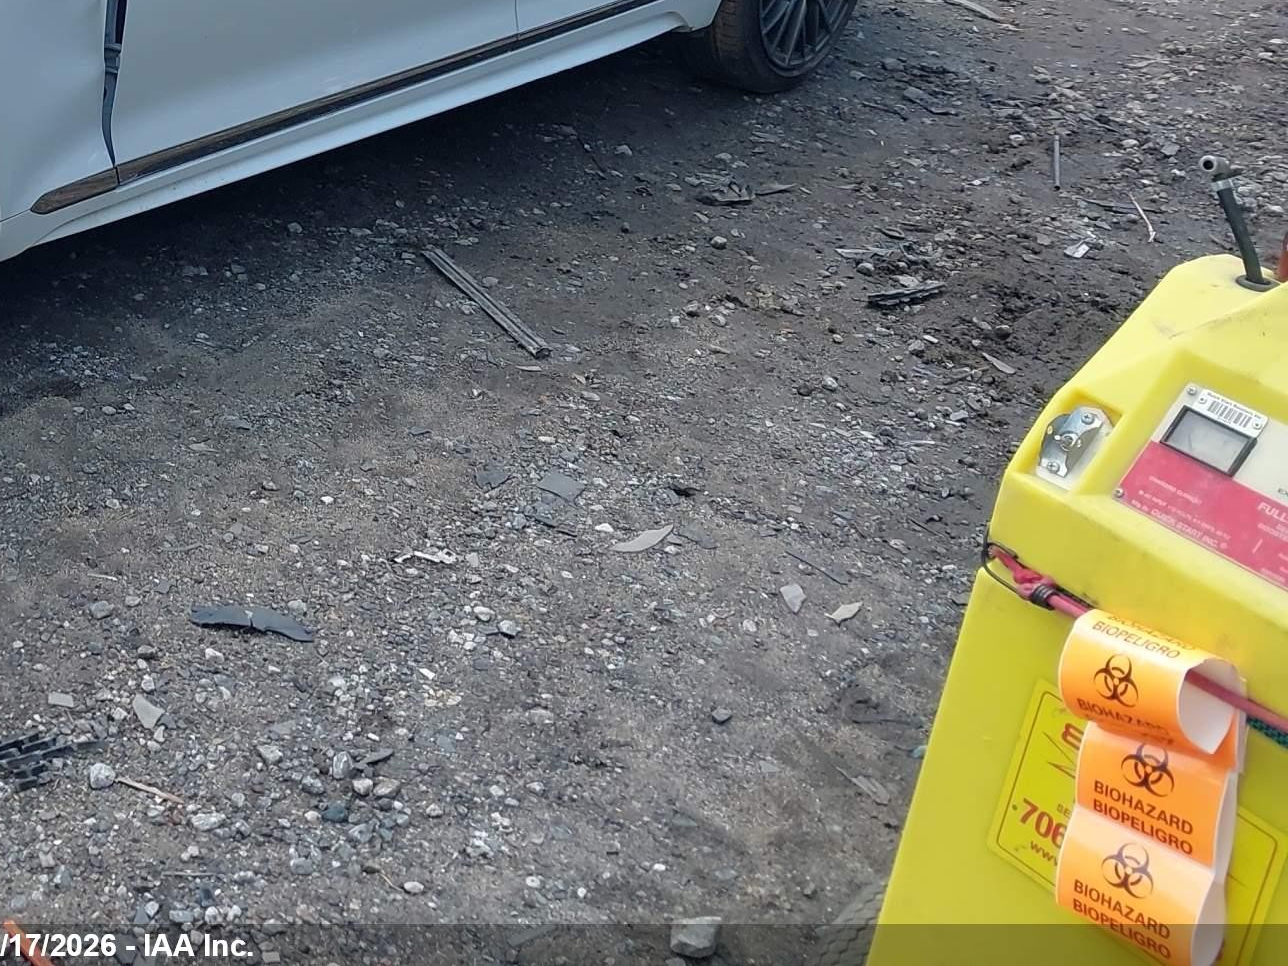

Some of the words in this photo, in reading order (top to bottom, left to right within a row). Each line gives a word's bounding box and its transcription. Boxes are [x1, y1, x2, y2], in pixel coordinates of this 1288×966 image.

[1092, 621, 1181, 659] BIOPELIGRO
[1093, 780, 1193, 836] BIOHAZARD
[1093, 799, 1193, 855] BIOPELIGRO
[1073, 879, 1171, 939] BIOHAZARD
[1073, 898, 1172, 959] BIOPELIGRO
